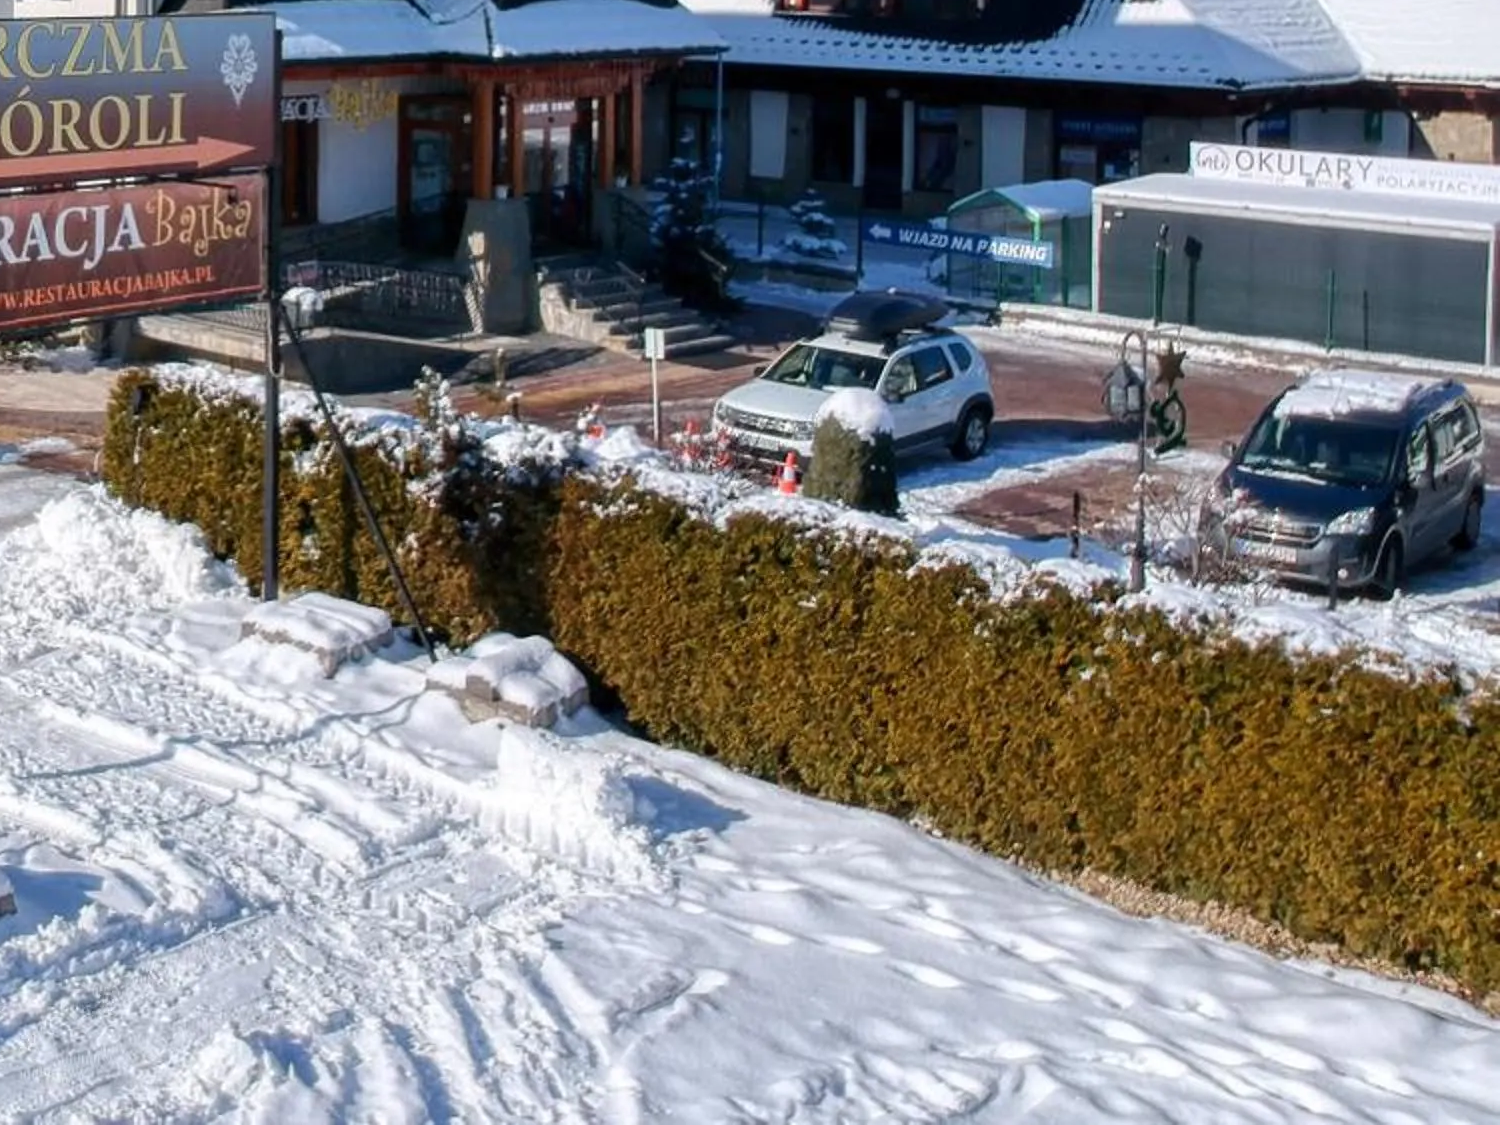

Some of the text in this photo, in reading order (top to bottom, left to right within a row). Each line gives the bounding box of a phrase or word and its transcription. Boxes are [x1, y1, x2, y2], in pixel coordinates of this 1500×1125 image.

[1235, 149, 1373, 182] OKULARY
[146, 185, 252, 257] Bajka
[899, 228, 1047, 261] WJAZD NA PARKING
